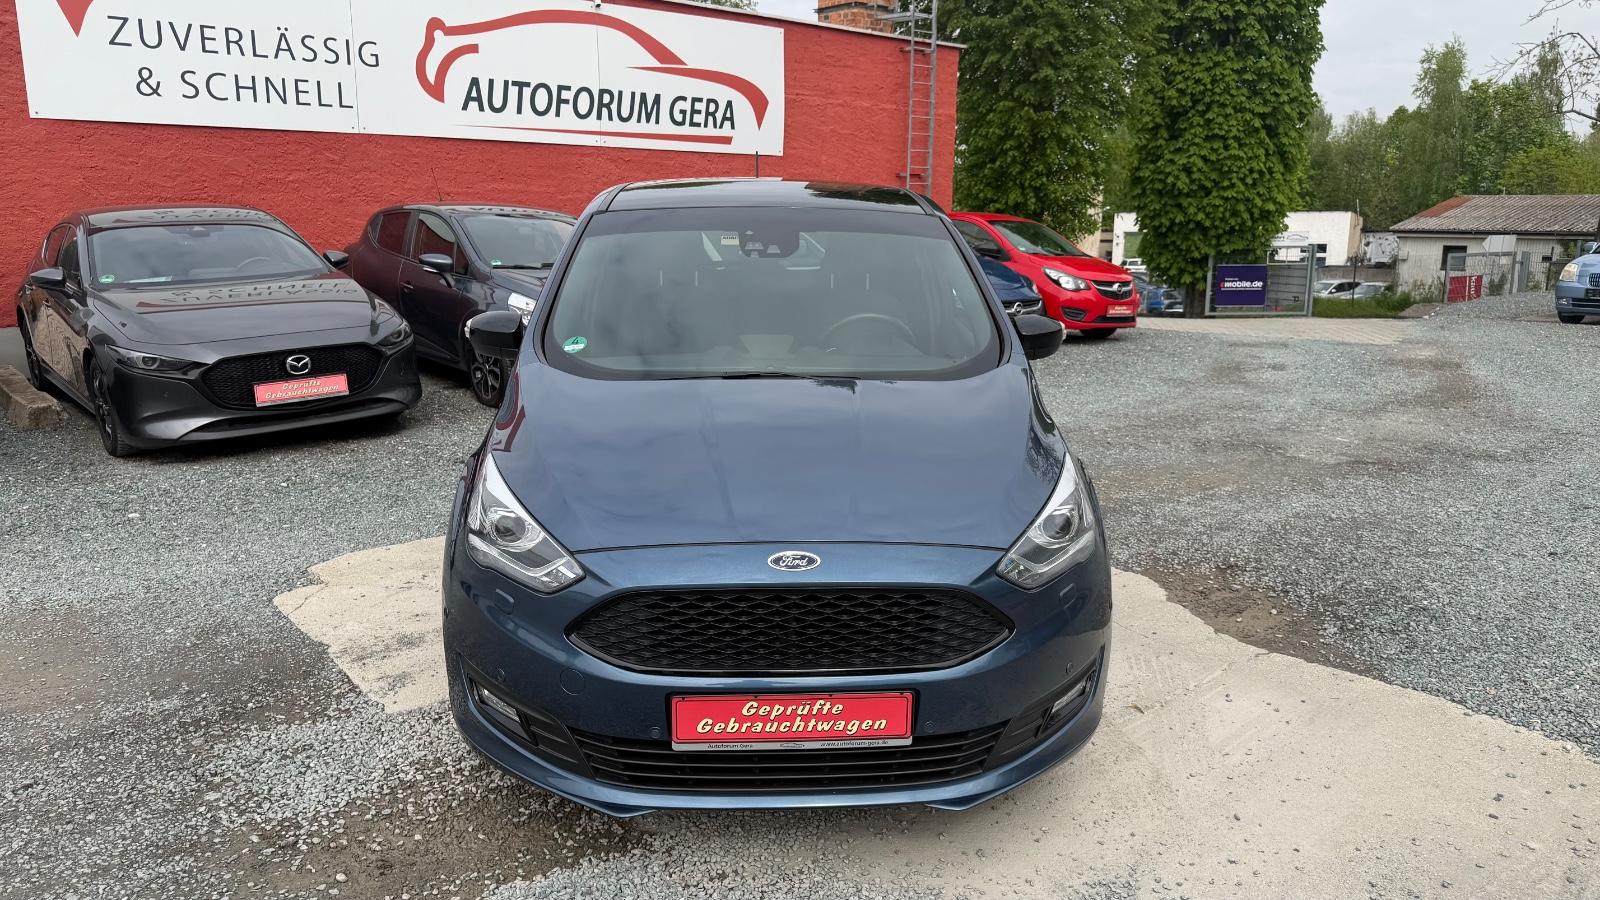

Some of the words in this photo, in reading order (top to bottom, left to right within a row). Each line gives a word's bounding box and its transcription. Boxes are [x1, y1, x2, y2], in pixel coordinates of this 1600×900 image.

[108, 15, 381, 68] ZUVERLÄSSIG
[135, 67, 163, 98] &
[181, 69, 354, 110] SCHNELL
[461, 76, 661, 128] AUTOFORUM
[669, 95, 737, 131] GERA
[571, 336, 580, 345] 4
[265, 385, 339, 399] Gebrauchtwagen
[282, 379, 321, 390] Geprüfte
[779, 555, 809, 566] Ford
[741, 699, 844, 719] Geprüfte
[696, 716, 887, 735] Gebrauchtwagen
